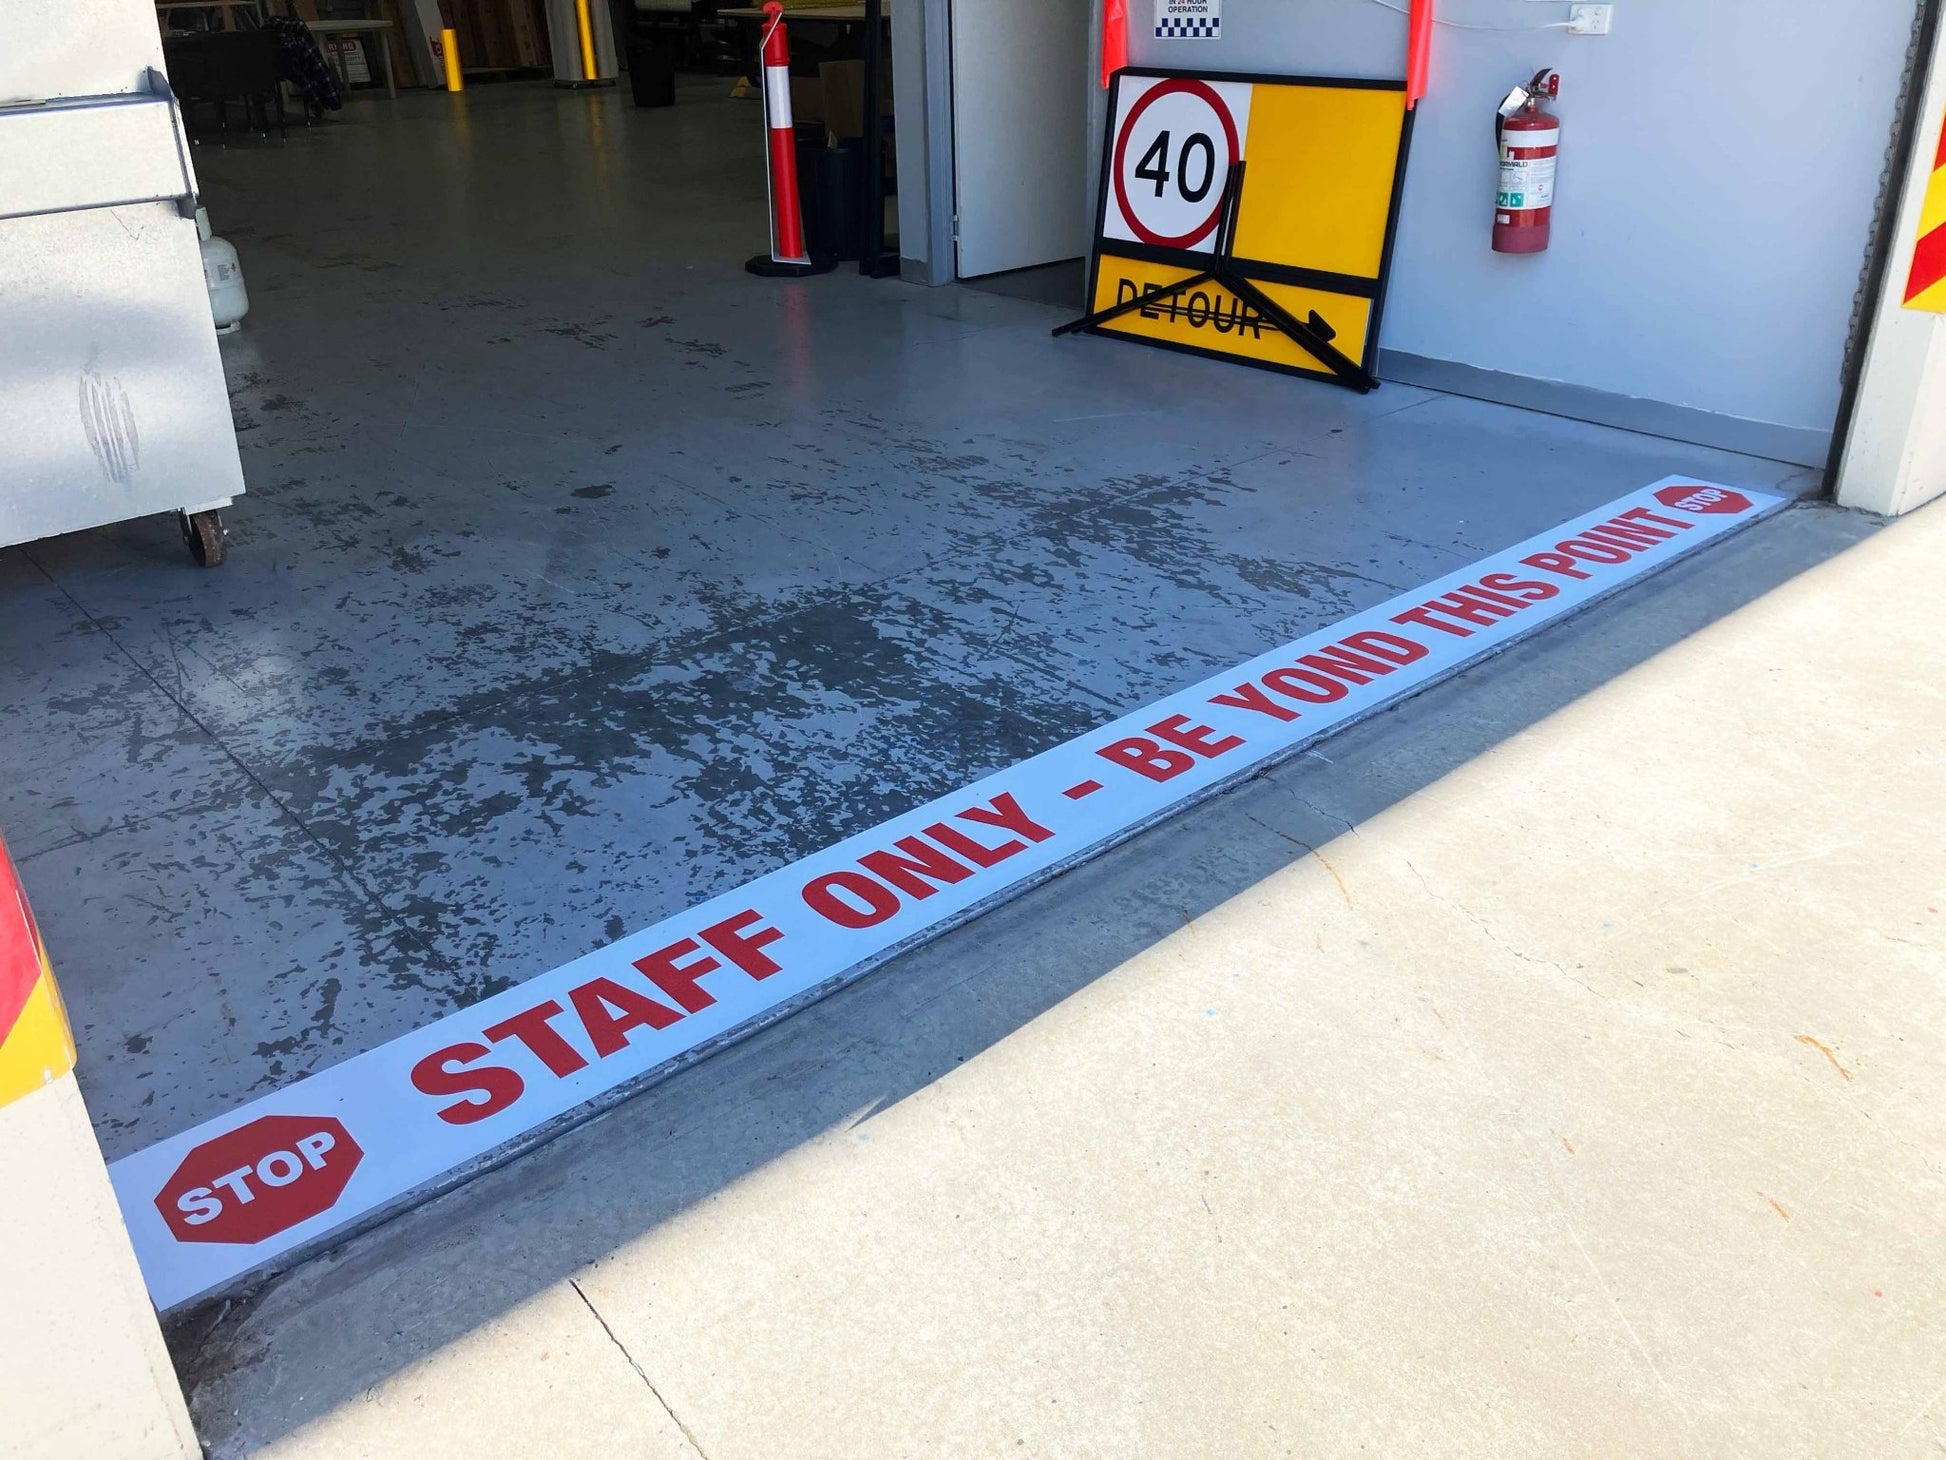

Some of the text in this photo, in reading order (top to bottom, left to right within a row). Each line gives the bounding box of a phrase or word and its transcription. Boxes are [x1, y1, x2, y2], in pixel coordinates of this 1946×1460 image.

[1168, 5, 1208, 13] OPERATION
[1135, 130, 1215, 203] 40
[1116, 278, 1262, 340] DETOUR
[1674, 487, 1728, 511] STOP
[410, 908, 785, 1125] STAFF
[801, 791, 1055, 929] ONLY
[1095, 713, 1247, 783] BE
[1207, 631, 1430, 722] YOND
[1388, 573, 1560, 637] THIS
[1518, 507, 1696, 580] POINT
[177, 1131, 336, 1226] STOP
